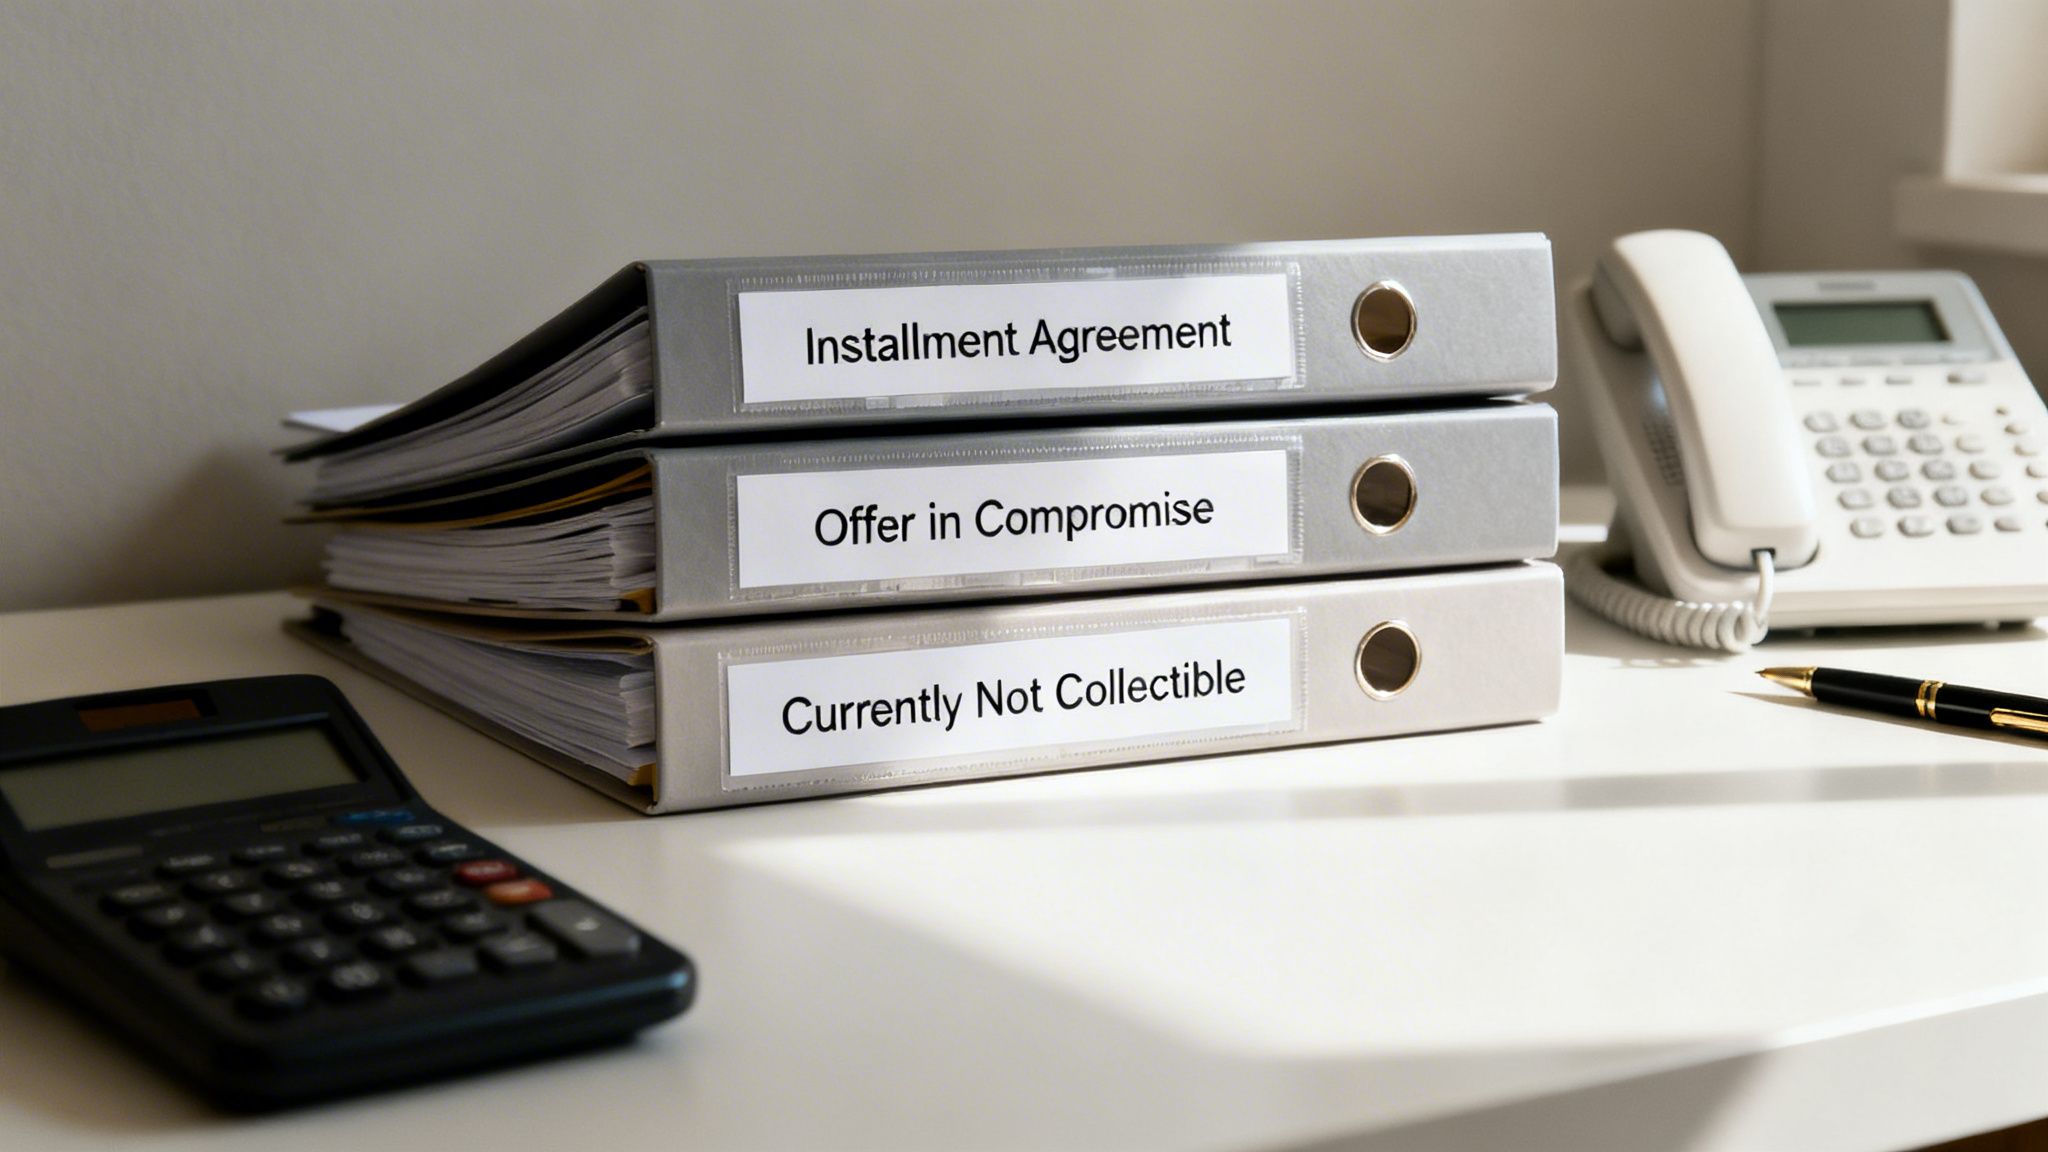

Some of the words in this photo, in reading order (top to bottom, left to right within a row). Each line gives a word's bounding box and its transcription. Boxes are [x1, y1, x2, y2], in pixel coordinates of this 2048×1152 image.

[807, 322, 1020, 364] Installment
[1029, 314, 1231, 363] Agreement
[815, 504, 916, 546] Offer
[929, 502, 960, 540] in
[975, 491, 1213, 541] Compromise
[783, 684, 962, 735] Currently
[977, 679, 1043, 717] Not
[1056, 660, 1245, 709] Collectible
